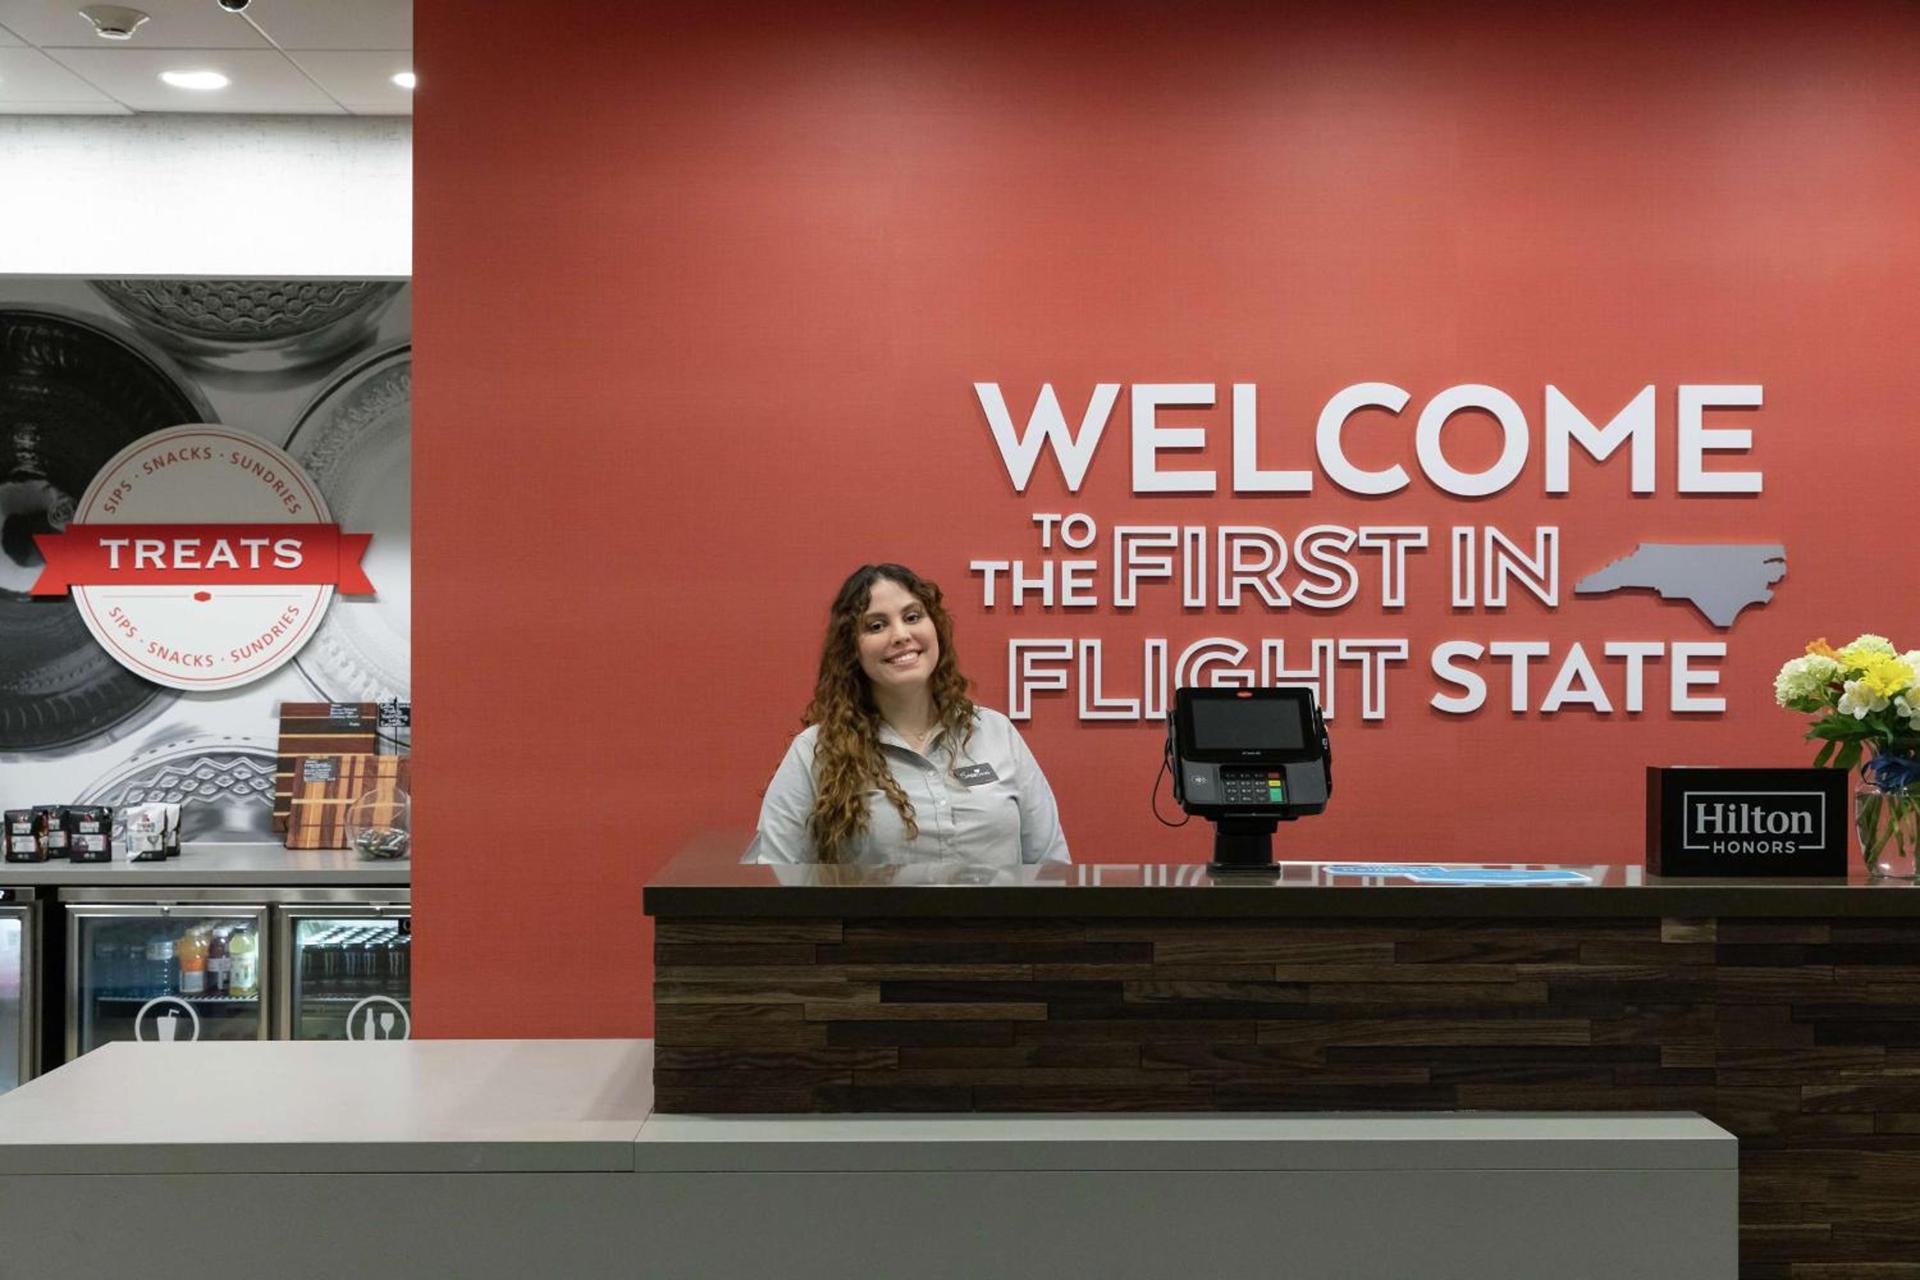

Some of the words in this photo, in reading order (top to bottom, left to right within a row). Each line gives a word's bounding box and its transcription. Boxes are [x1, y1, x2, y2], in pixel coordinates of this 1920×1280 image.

[974, 382, 1763, 496] WELCOME
[104, 481, 133, 515] SIPS
[142, 446, 212, 475] SNACKS
[230, 451, 302, 515] SUNDRIES
[100, 538, 303, 570] TREATS
[1032, 513, 1096, 549] TO
[970, 560, 1097, 606] THE
[1113, 524, 1428, 608] FIRST
[1452, 526, 1558, 607] IN
[108, 606, 137, 639] SIPS
[147, 641, 214, 667] SNACKS
[230, 605, 300, 663] SUNDRIES
[1430, 641, 1727, 713] STATE
[1695, 803, 1813, 834] Hilton
[1713, 841, 1795, 854] HONORS
